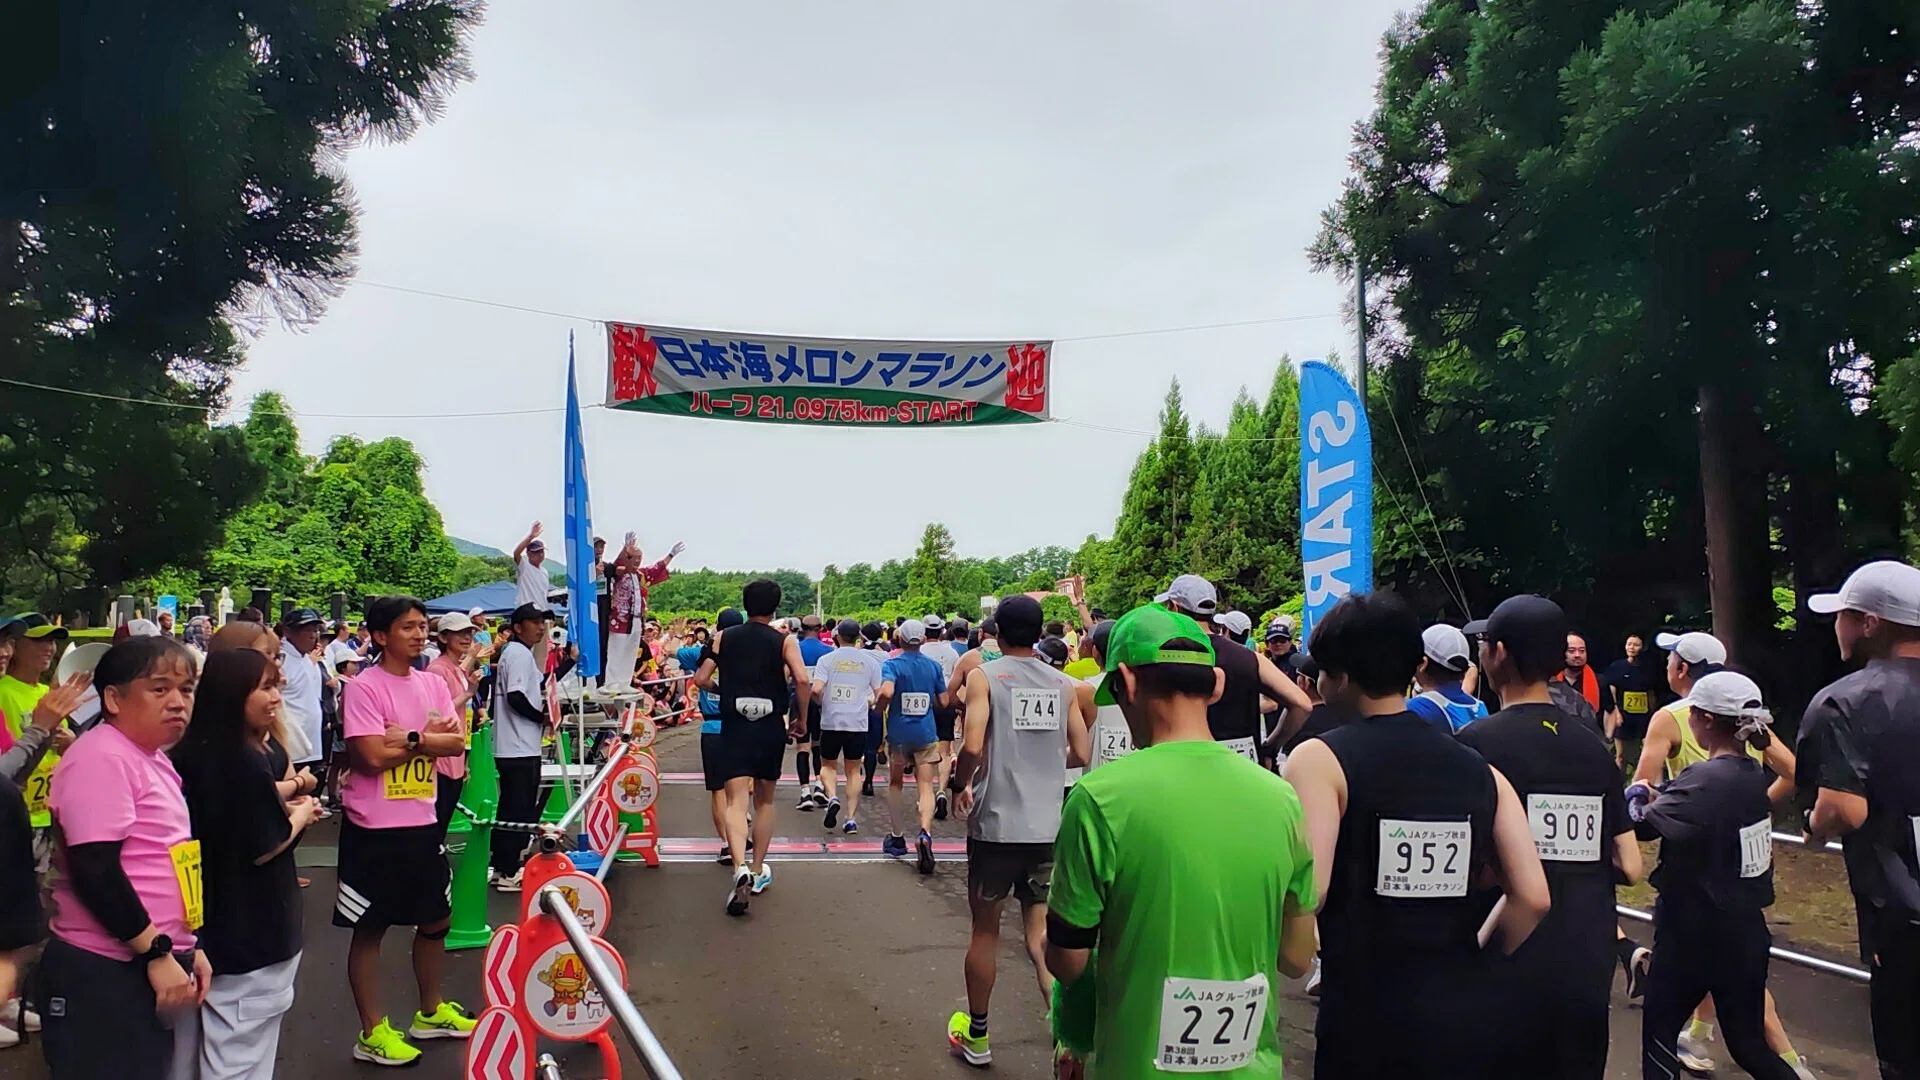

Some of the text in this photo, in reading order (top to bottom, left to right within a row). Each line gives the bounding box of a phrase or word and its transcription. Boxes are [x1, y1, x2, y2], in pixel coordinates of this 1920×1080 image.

[651, 336, 1007, 389] 日本海メロンマラソン
[1005, 343, 1047, 412] 迎
[690, 391, 753, 416] ハーフ
[837, 688, 851, 698] 90
[905, 699, 927, 708] 780
[742, 704, 766, 716] 631
[1020, 699, 1055, 718] 744
[391, 757, 433, 784] 1702
[1543, 812, 1595, 841] 908
[1396, 842, 1459, 874] 952
[1536, 847, 1598, 857] 本海メロンマラ
[1382, 882, 1464, 891] 日本海メロンマラソン
[1179, 1001, 1258, 1045] 227
